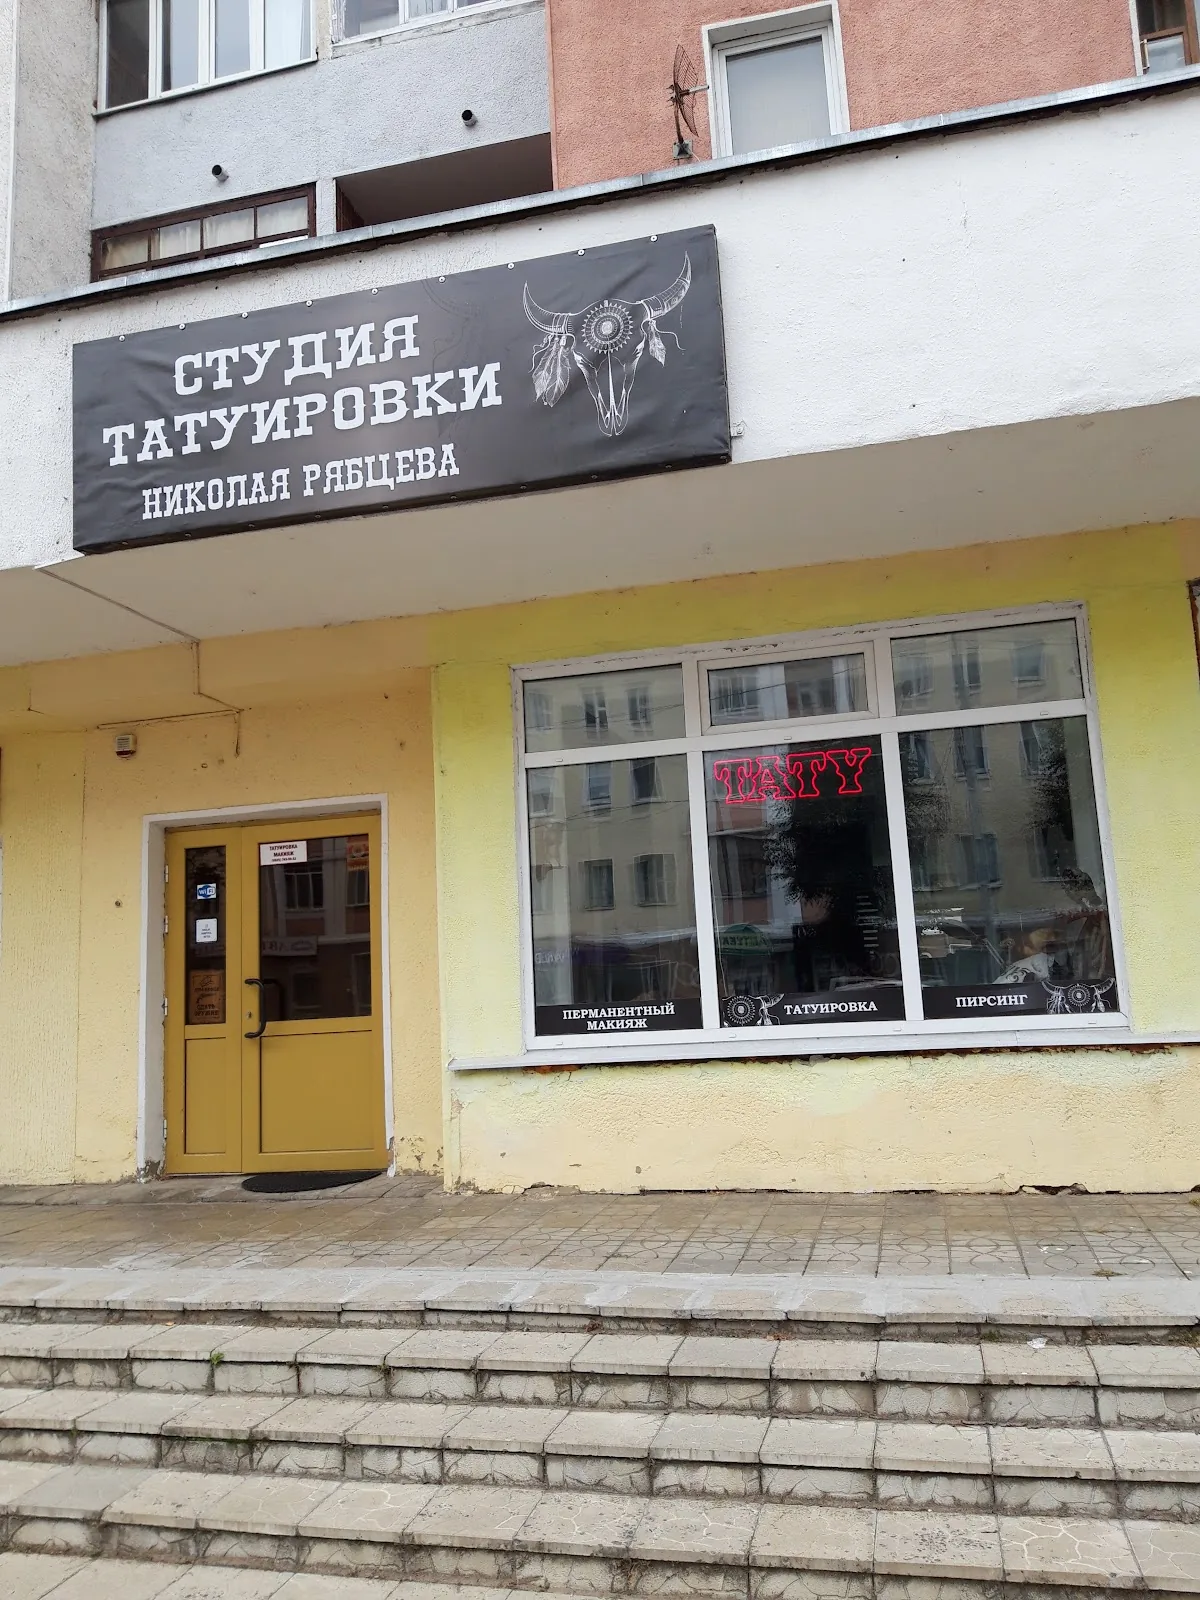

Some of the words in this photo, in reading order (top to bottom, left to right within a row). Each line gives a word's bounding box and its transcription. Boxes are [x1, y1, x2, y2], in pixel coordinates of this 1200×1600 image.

[173, 315, 419, 395] СТУДИЯ
[103, 362, 502, 466] ТАТУИРОВКИ
[142, 468, 291, 520] НИКОЛАЯ
[302, 443, 460, 497] РЯБЦЕВА
[784, 1001, 878, 1015] ТАТУИРОВКА
[955, 994, 1028, 1008] ПИРСИНГ
[562, 1002, 675, 1020] ПЕРМАНЕНТНЫЙ
[587, 1018, 648, 1031] МАКИЯЖ
